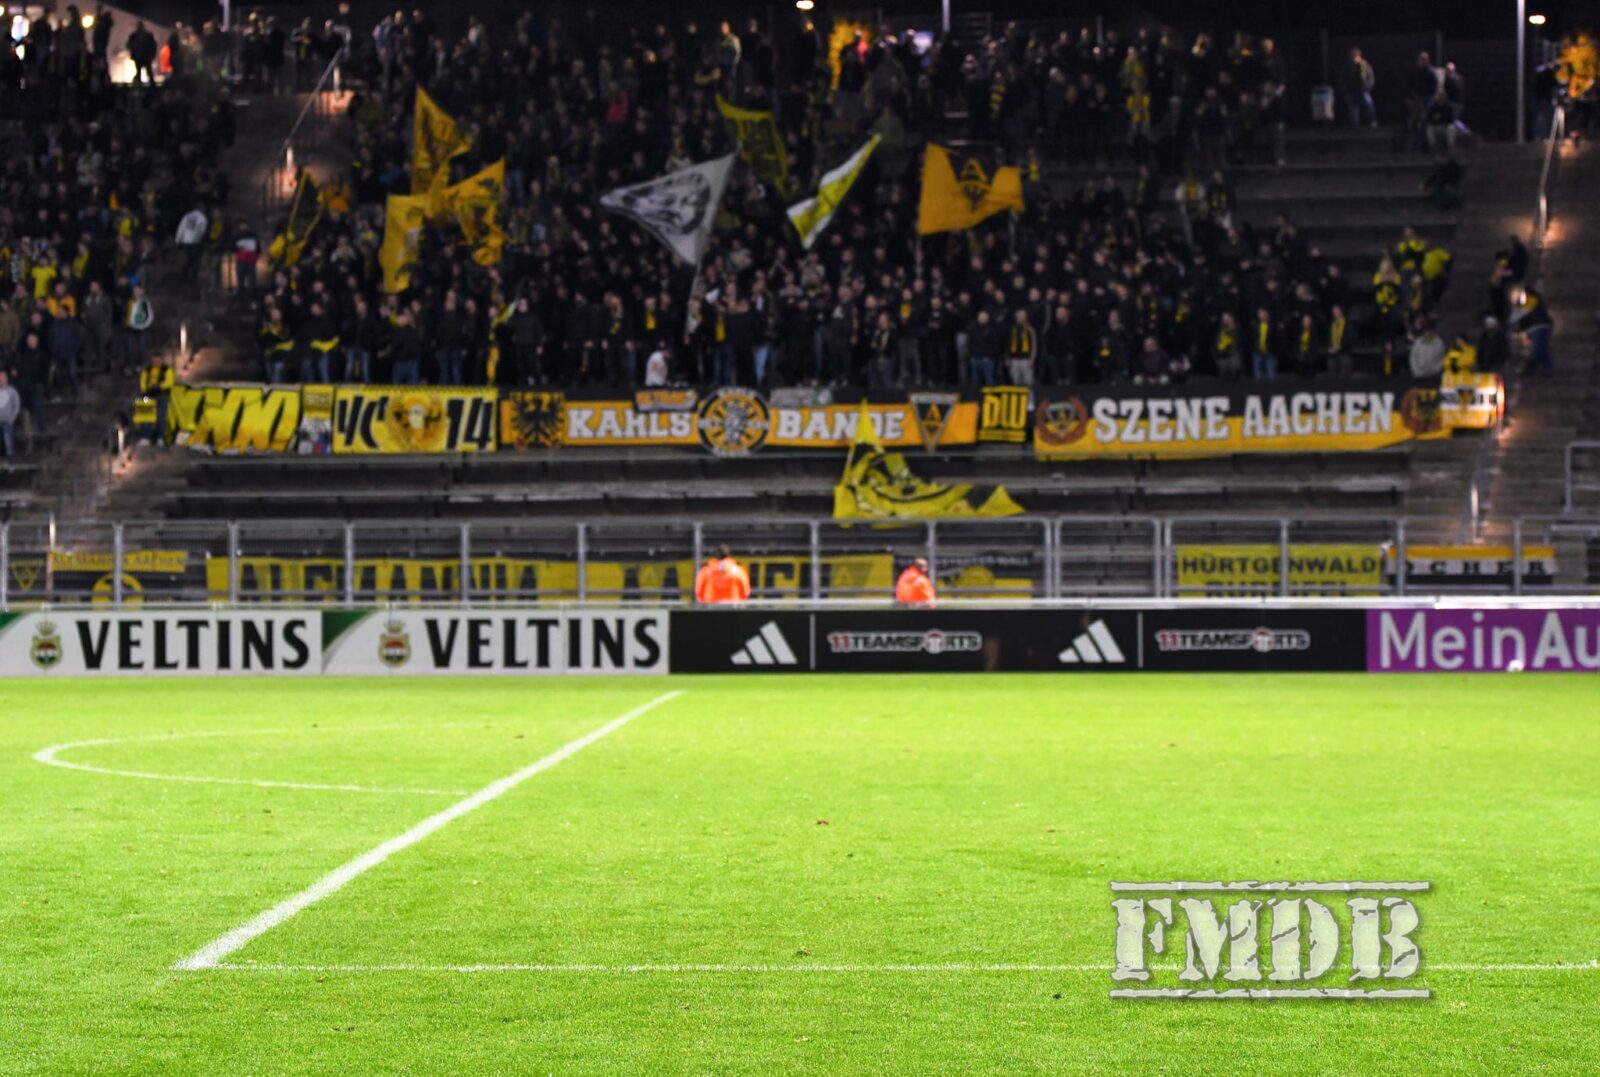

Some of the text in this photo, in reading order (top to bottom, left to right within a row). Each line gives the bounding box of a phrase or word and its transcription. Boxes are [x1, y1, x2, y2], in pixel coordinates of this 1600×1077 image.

[446, 396, 493, 450] 14
[1092, 397, 1231, 443] SZENE
[1241, 392, 1396, 437] AACHEN
[1182, 553, 1376, 574] HÜRTGENWALD
[75, 619, 310, 670] VELTINS
[423, 618, 661, 669] VELTINS
